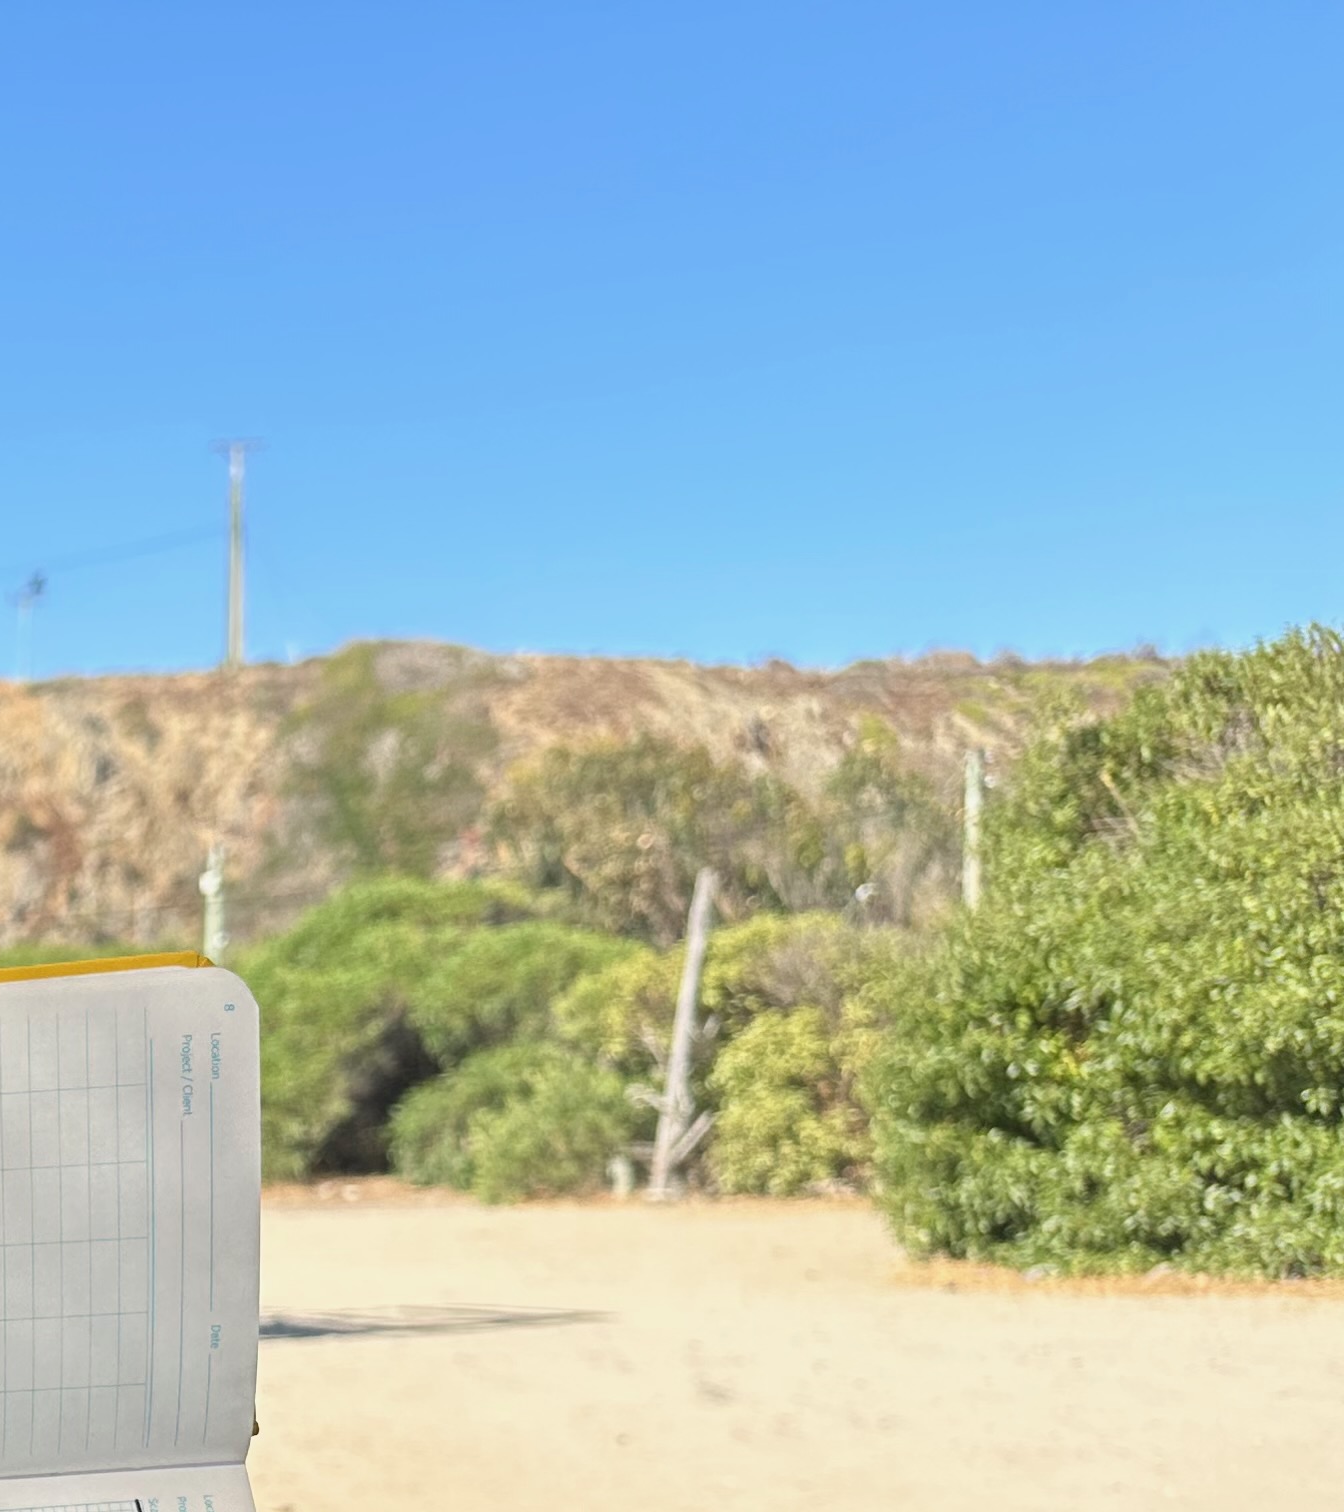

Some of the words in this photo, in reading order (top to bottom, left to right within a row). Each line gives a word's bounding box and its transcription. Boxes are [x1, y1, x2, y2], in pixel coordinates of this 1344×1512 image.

[223, 1003, 235, 1012] 8
[180, 1034, 192, 1073] Project
[210, 1032, 221, 1080] Location
[182, 1085, 194, 1117] Client
[210, 1324, 221, 1350] Date
